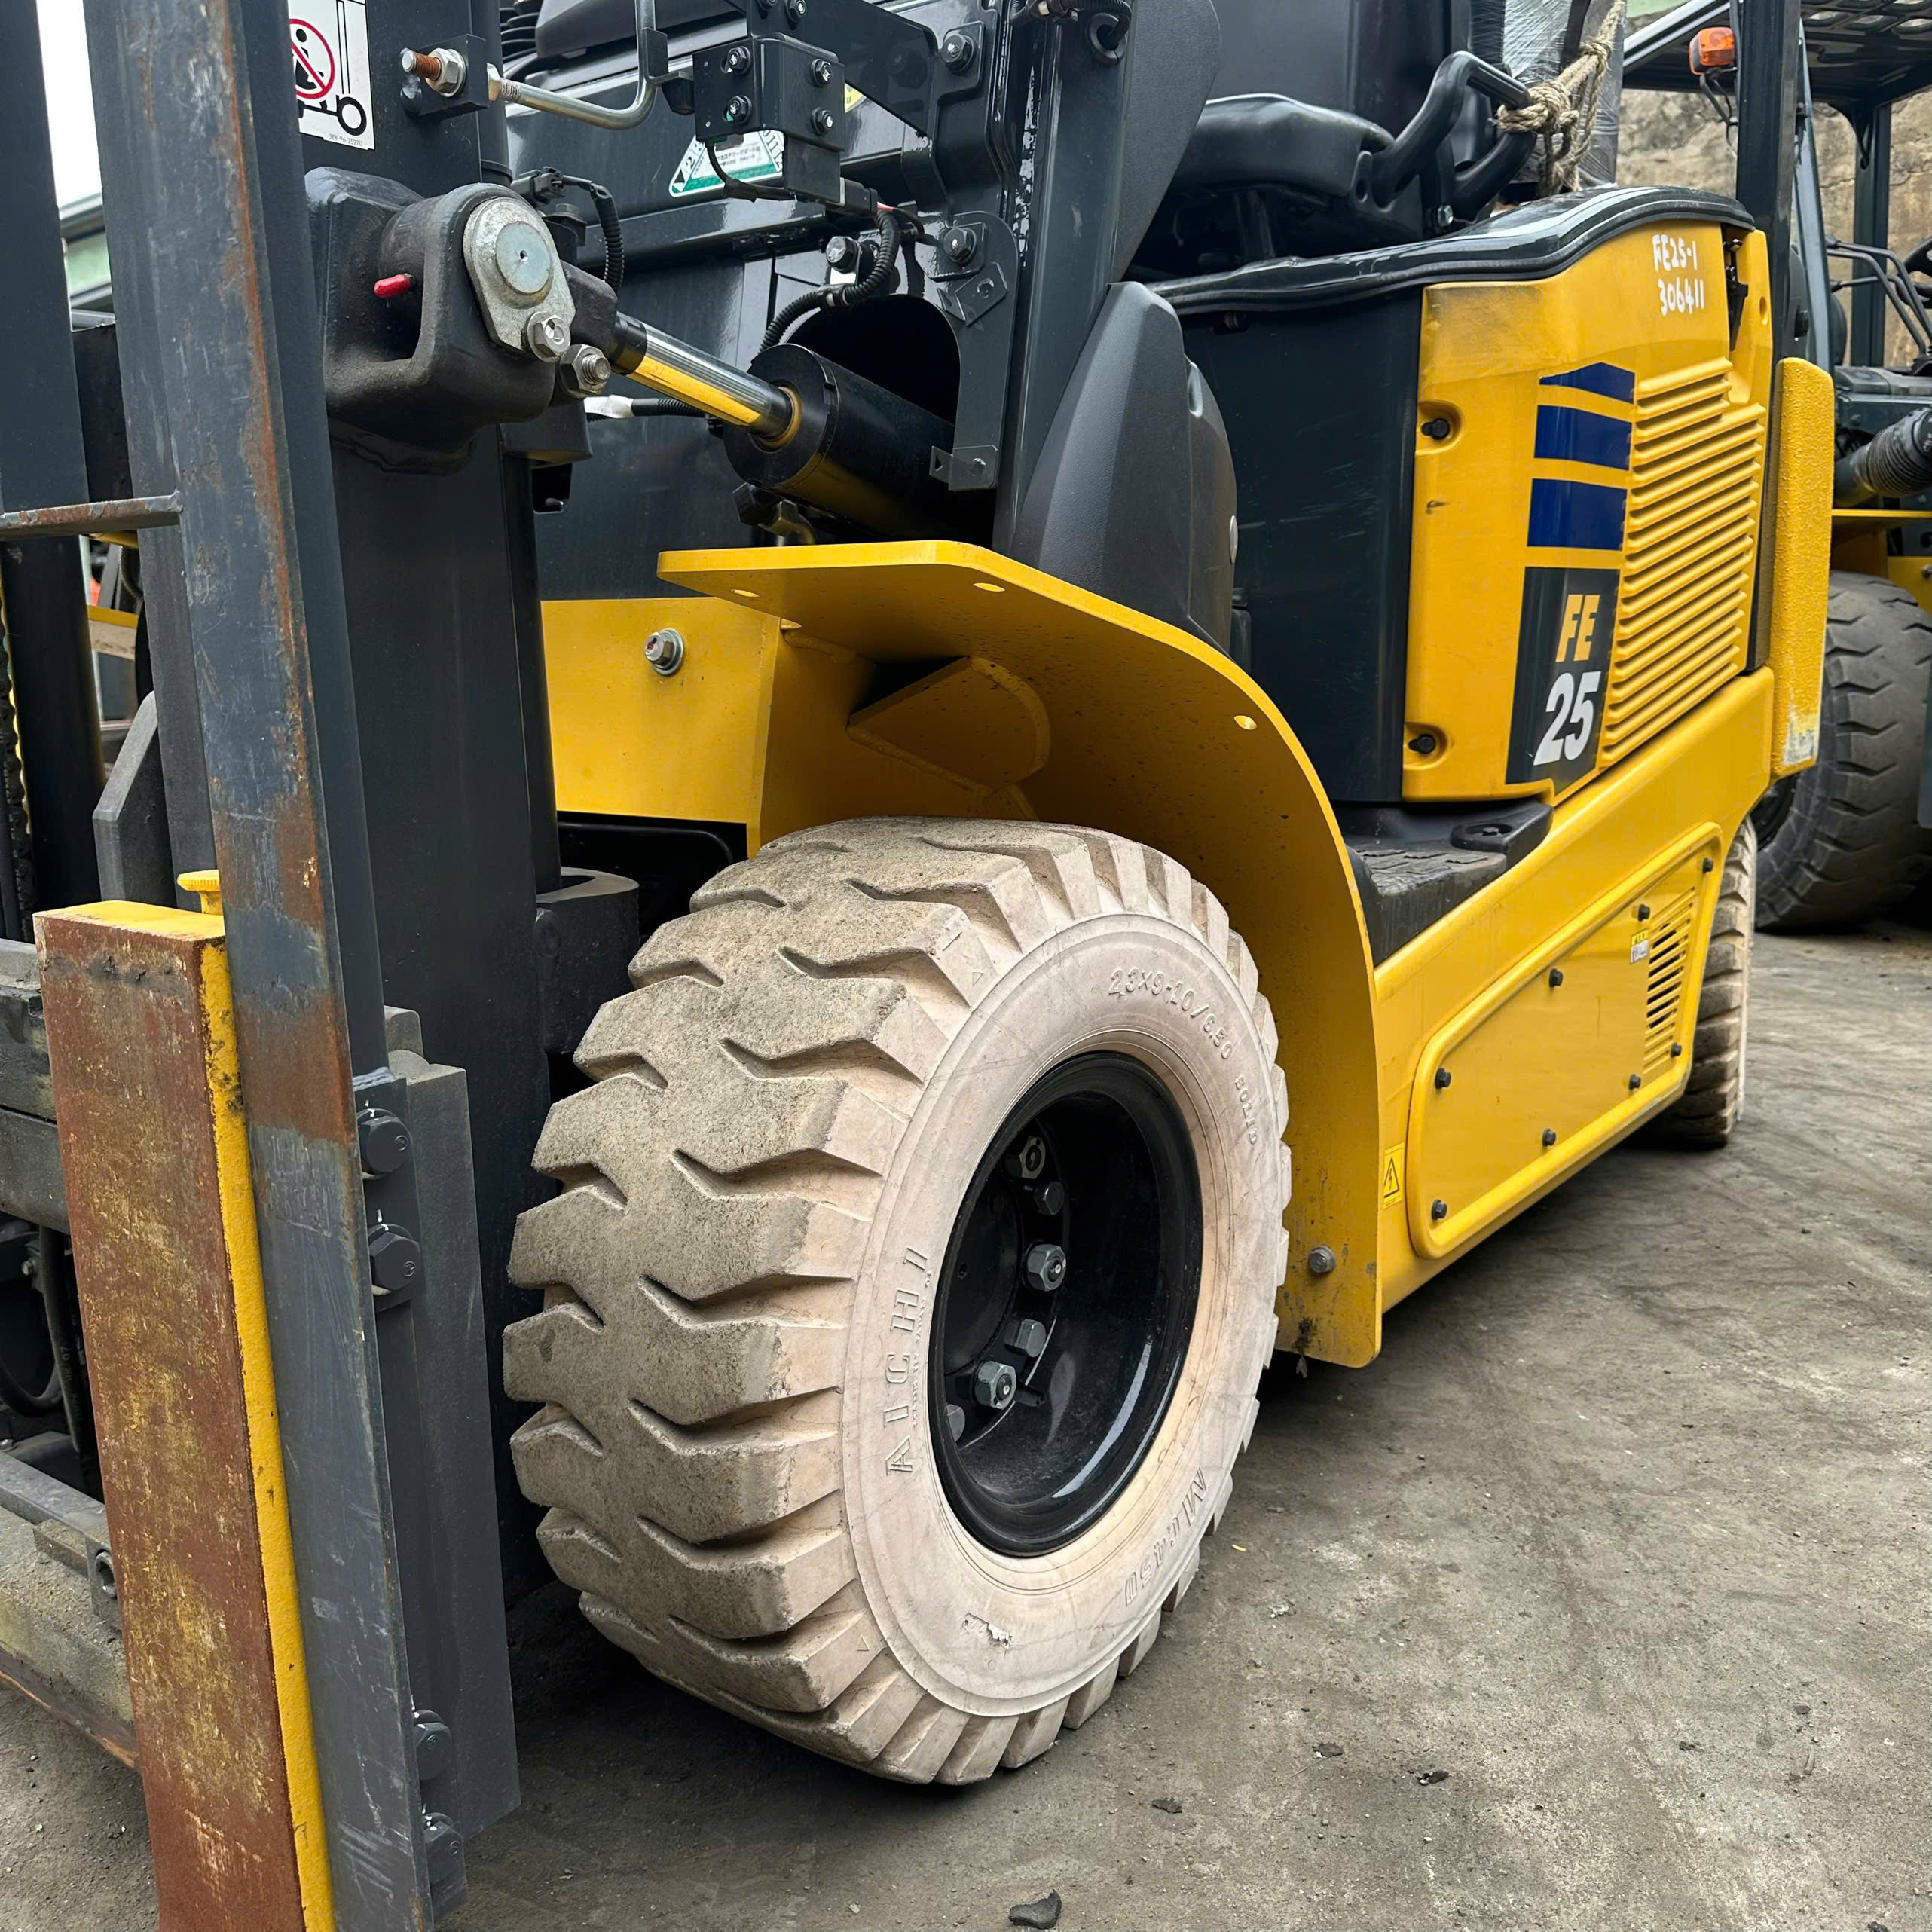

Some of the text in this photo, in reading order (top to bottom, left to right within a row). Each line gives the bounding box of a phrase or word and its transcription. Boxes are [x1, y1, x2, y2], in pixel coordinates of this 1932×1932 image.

[686, 156, 695, 170] 2
[1652, 234, 1698, 272] FE25-1
[1658, 277, 1705, 317] 306411
[1555, 594, 1600, 662] FE
[1533, 671, 1601, 766] 25
[883, 1247, 928, 1476] AICHI
